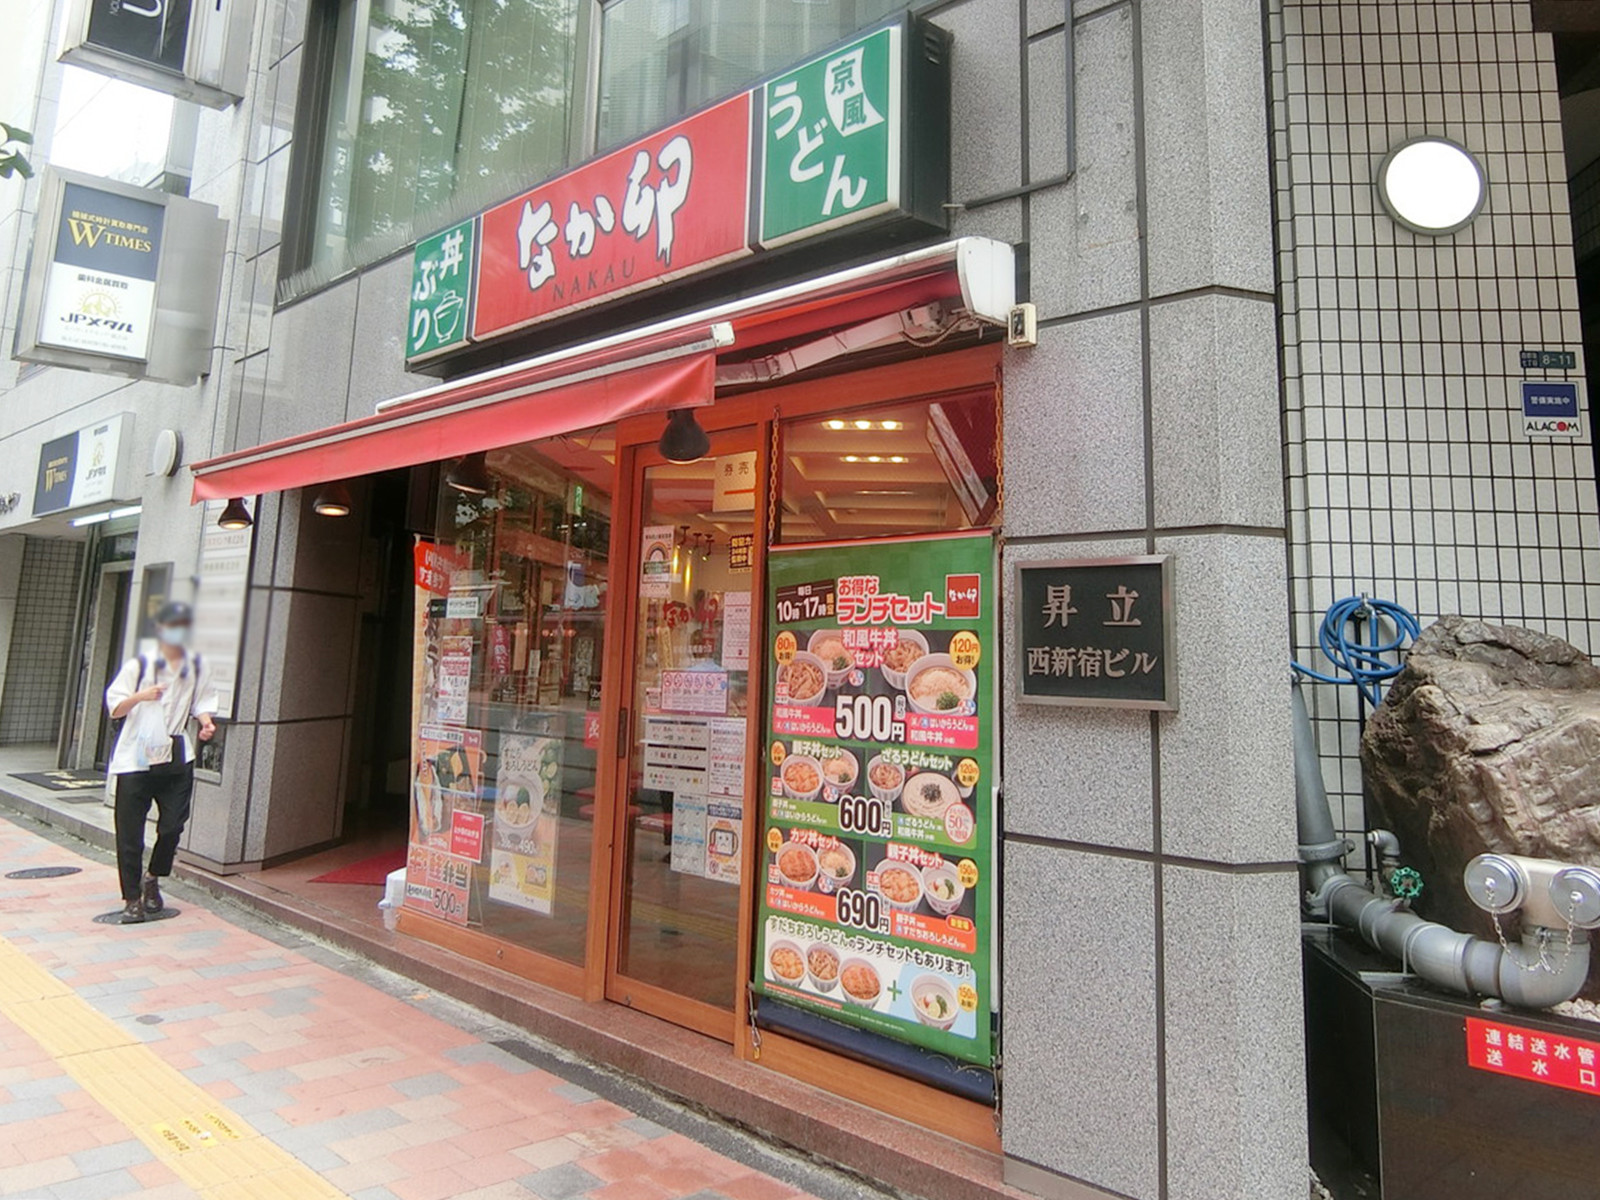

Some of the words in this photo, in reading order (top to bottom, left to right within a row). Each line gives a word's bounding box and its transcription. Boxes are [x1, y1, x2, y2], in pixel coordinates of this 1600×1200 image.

[831, 59, 866, 132] 京風
[769, 81, 867, 215] うどん
[518, 135, 692, 290] なか卯
[553, 257, 635, 300] NAKAU
[60, 313, 133, 333] JPメタル
[1542, 354, 1571, 365] 8-11
[1526, 421, 1579, 432] ALACOM
[838, 578, 877, 596] お得な
[838, 593, 943, 623] ランチセット
[843, 629, 897, 648] 和風牛丼
[953, 638, 978, 653] 120円
[854, 651, 884, 667] セット
[1027, 646, 1158, 678] 西新宿ビル
[836, 695, 905, 742] 500円
[881, 748, 953, 771] ざるうどんセット
[840, 797, 891, 836] 600円
[837, 889, 890, 933] 690円
[1485, 1028, 1595, 1066] 連結送水管
[1486, 1048, 1596, 1087] 送水口
